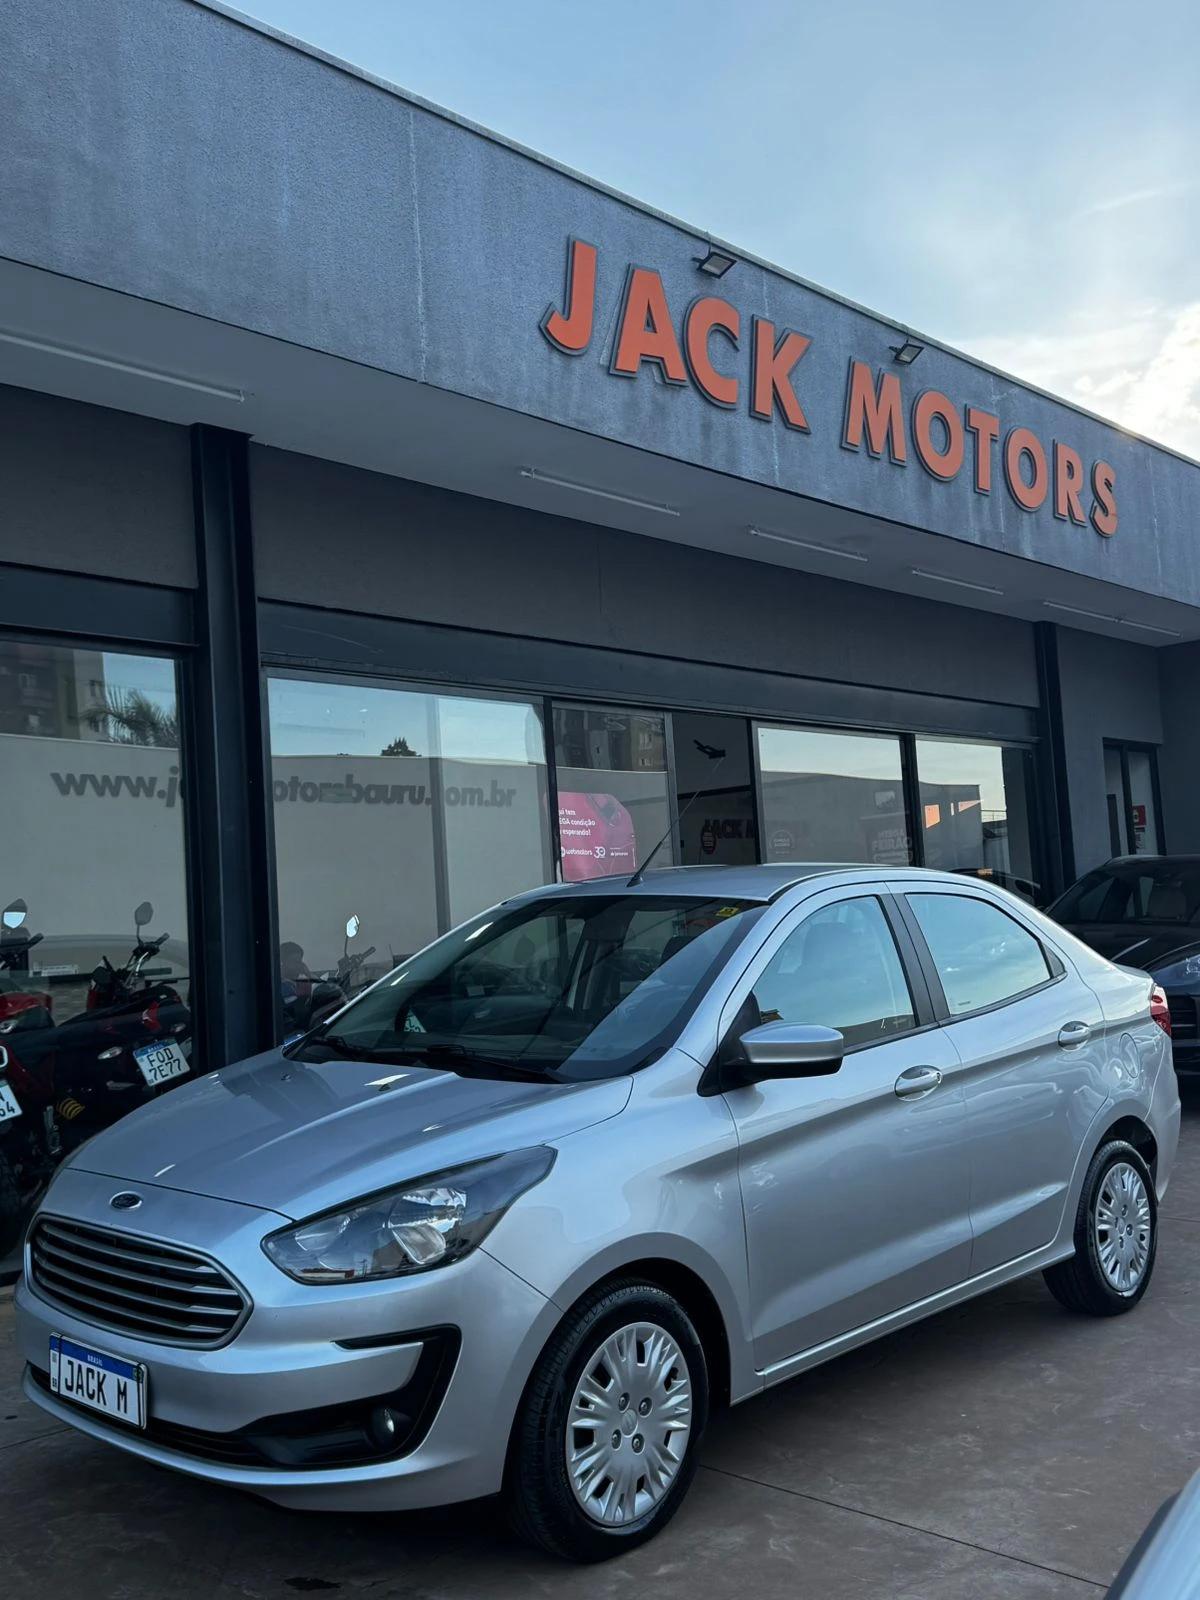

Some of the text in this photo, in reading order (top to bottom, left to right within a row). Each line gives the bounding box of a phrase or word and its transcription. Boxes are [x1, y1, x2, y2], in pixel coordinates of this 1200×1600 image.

[540, 237, 1119, 536] JACK MOTORS
[563, 829, 591, 837] esperando!
[571, 818, 596, 827] condição
[147, 1047, 174, 1068] FOD
[149, 1058, 182, 1081] 7E77
[87, 1354, 103, 1367] BRASIL
[65, 1359, 127, 1414] JACK M
